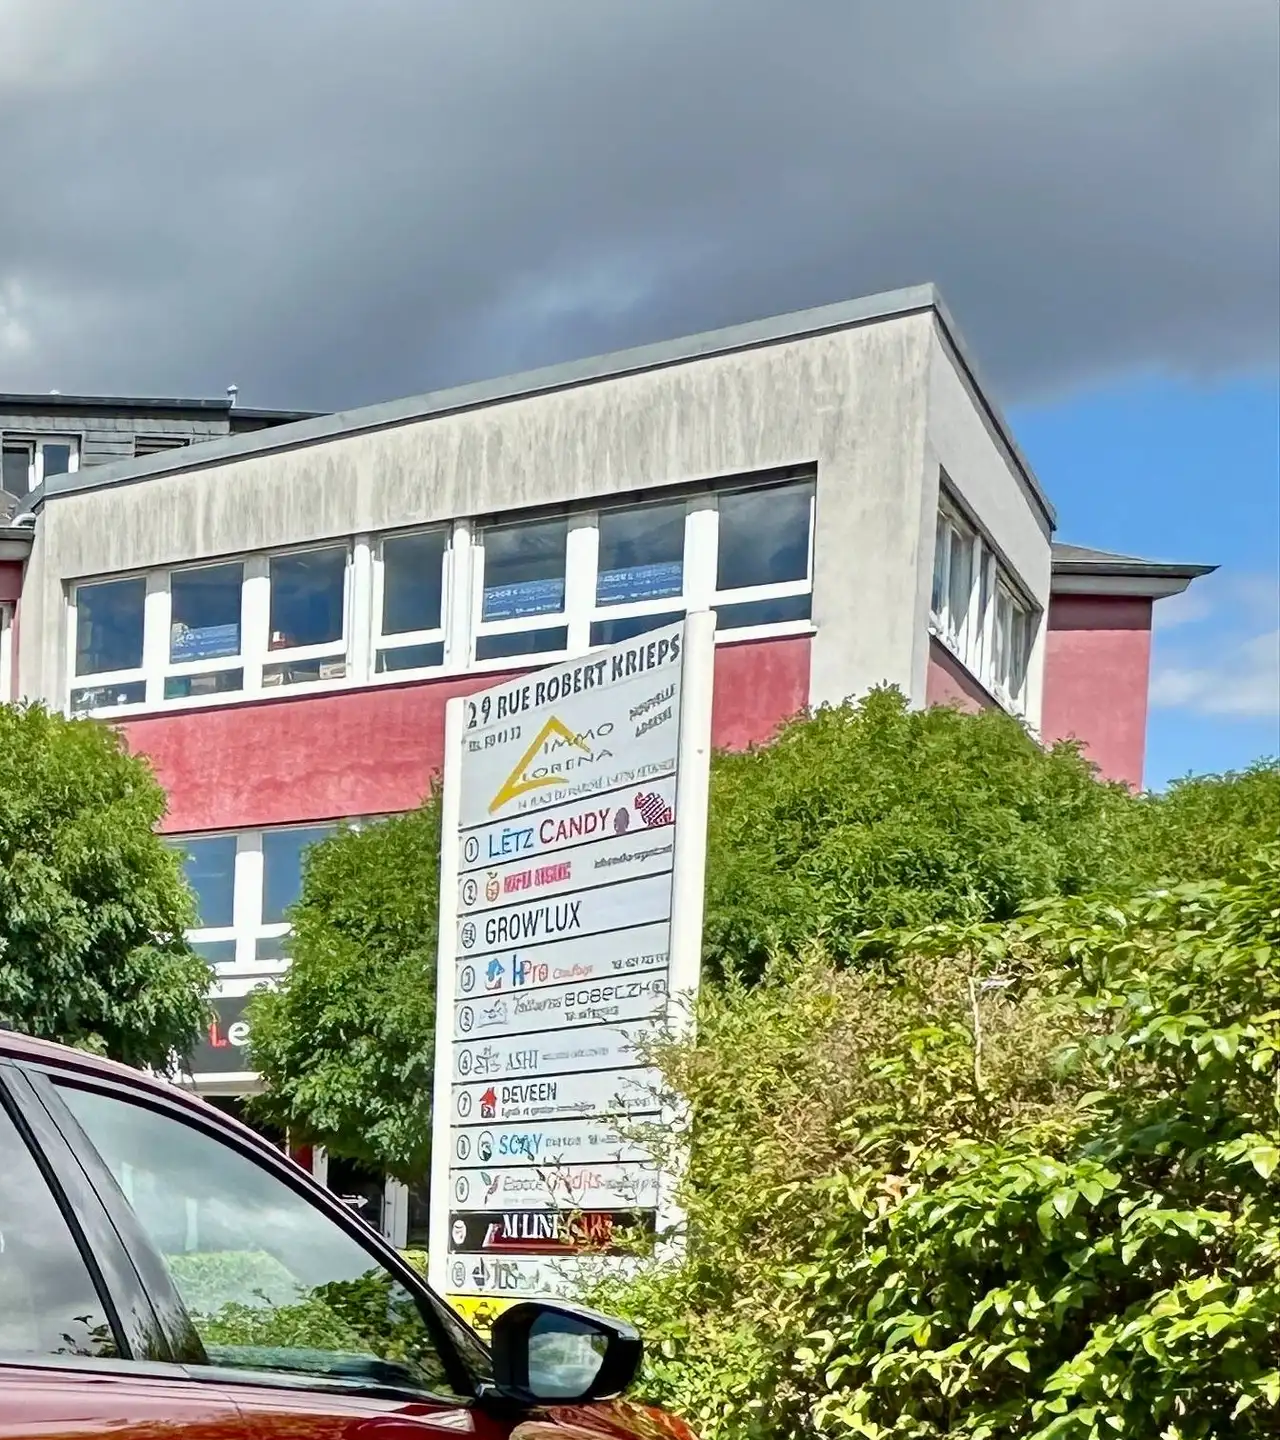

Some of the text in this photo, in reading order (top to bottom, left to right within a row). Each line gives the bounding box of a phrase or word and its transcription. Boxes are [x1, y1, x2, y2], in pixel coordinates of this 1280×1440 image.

[467, 633, 681, 729] 29 RUE ROBERT KRIEPS
[544, 722, 614, 754] IMMO
[523, 749, 614, 782] LORENA
[488, 827, 534, 858] LËTZ
[539, 807, 611, 845] CANDY
[485, 900, 582, 945] GROW'LUX
[501, 1081, 557, 1105] DEVEEN
